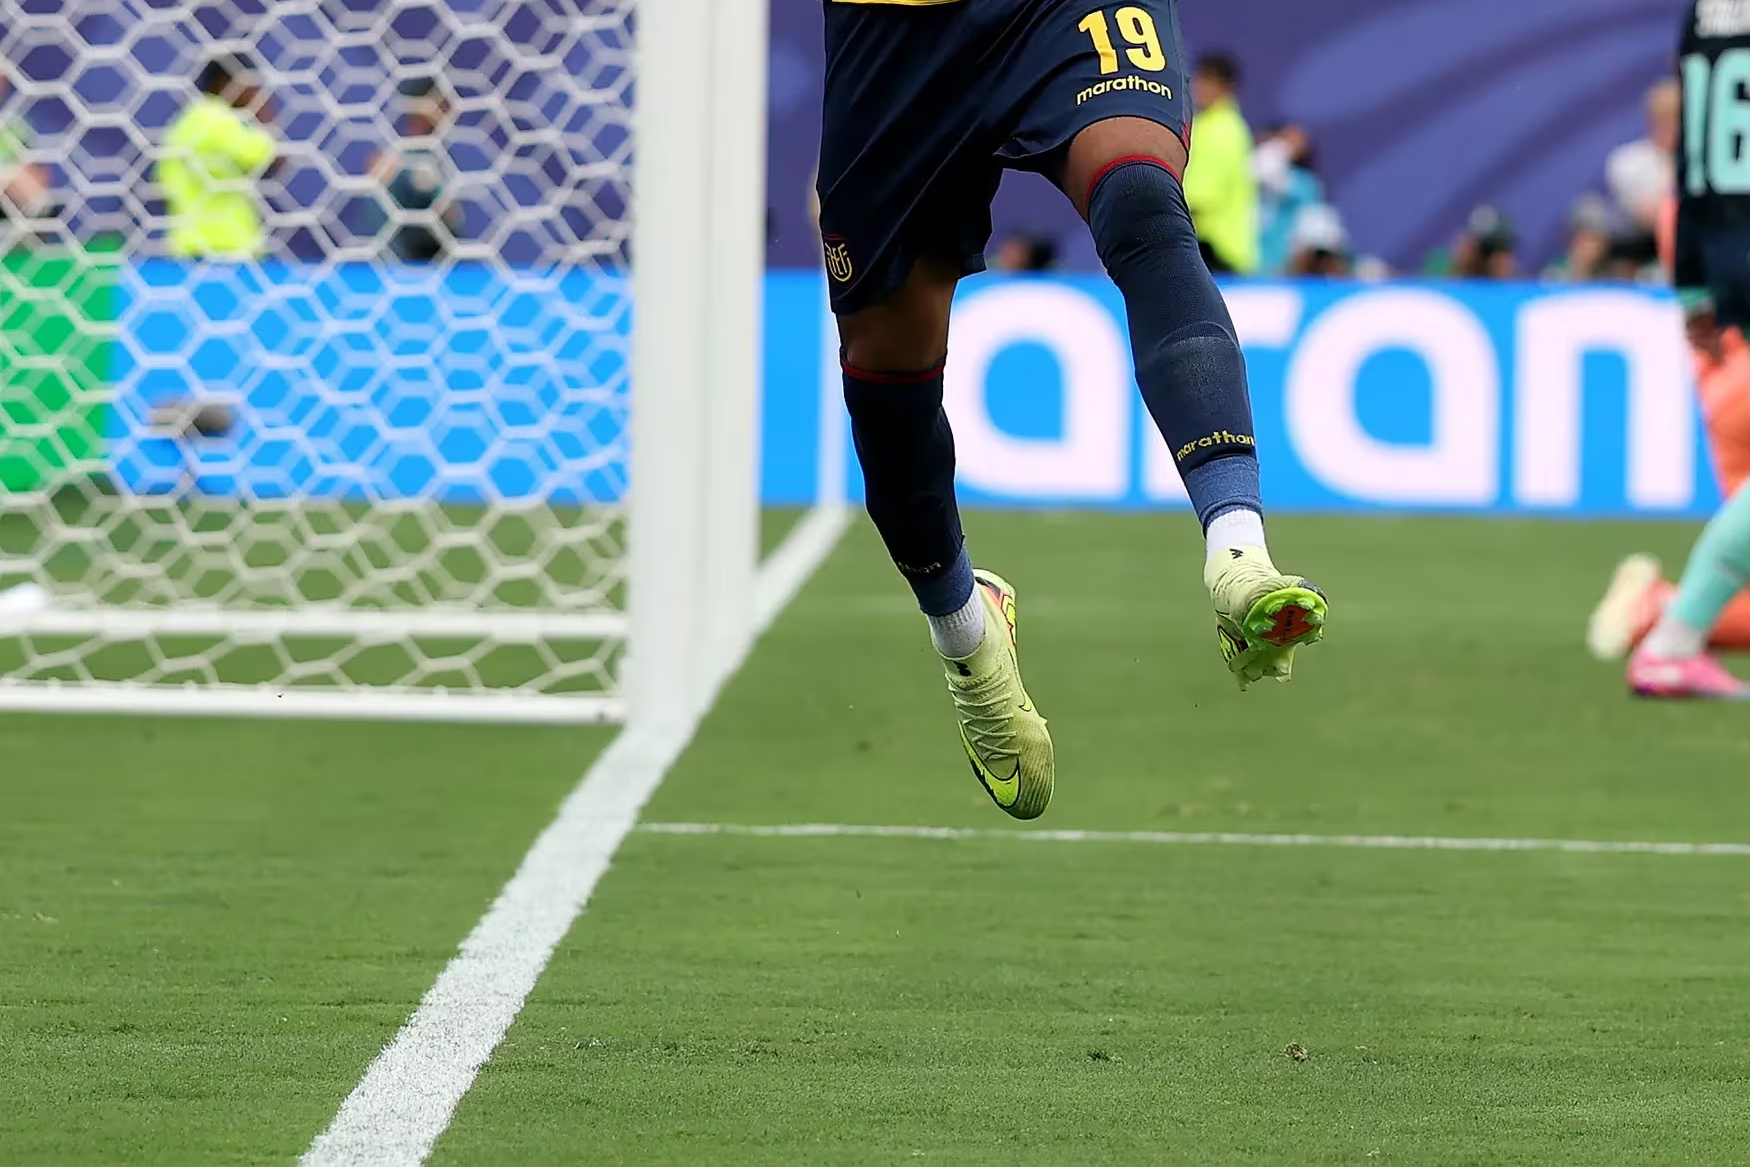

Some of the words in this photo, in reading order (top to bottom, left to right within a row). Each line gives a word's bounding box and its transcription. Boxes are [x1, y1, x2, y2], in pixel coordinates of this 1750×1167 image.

[1078, 6, 1166, 75] 19
[1076, 75, 1173, 106] marathon
[1176, 430, 1255, 462] marathon
